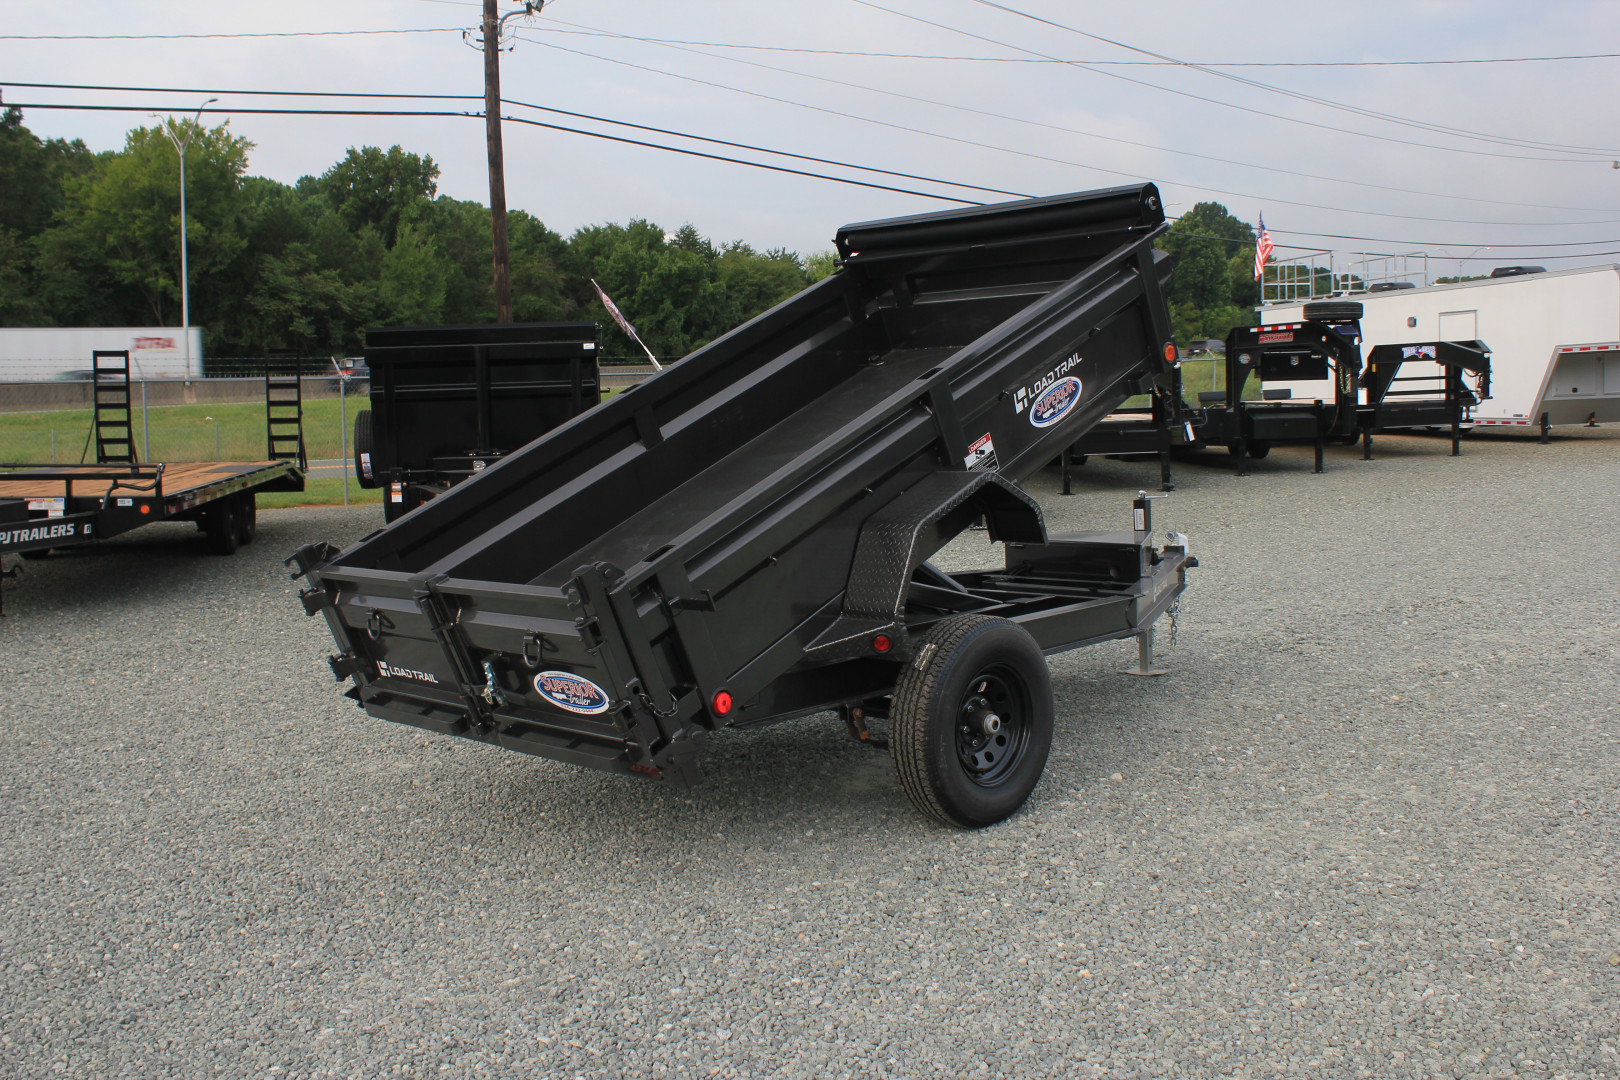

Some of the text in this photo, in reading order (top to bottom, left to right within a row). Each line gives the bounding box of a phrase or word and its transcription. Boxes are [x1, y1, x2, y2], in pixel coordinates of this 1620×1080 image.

[1028, 371, 1055, 399] LOAD
[1054, 352, 1083, 378] TRAIL
[1035, 378, 1076, 416] SUPERIOR
[970, 437, 987, 452] DANGER
[12, 523, 75, 543] TRAILERS
[389, 665, 439, 684] LOAD TRAIL
[540, 675, 600, 700] SUPERIOR
